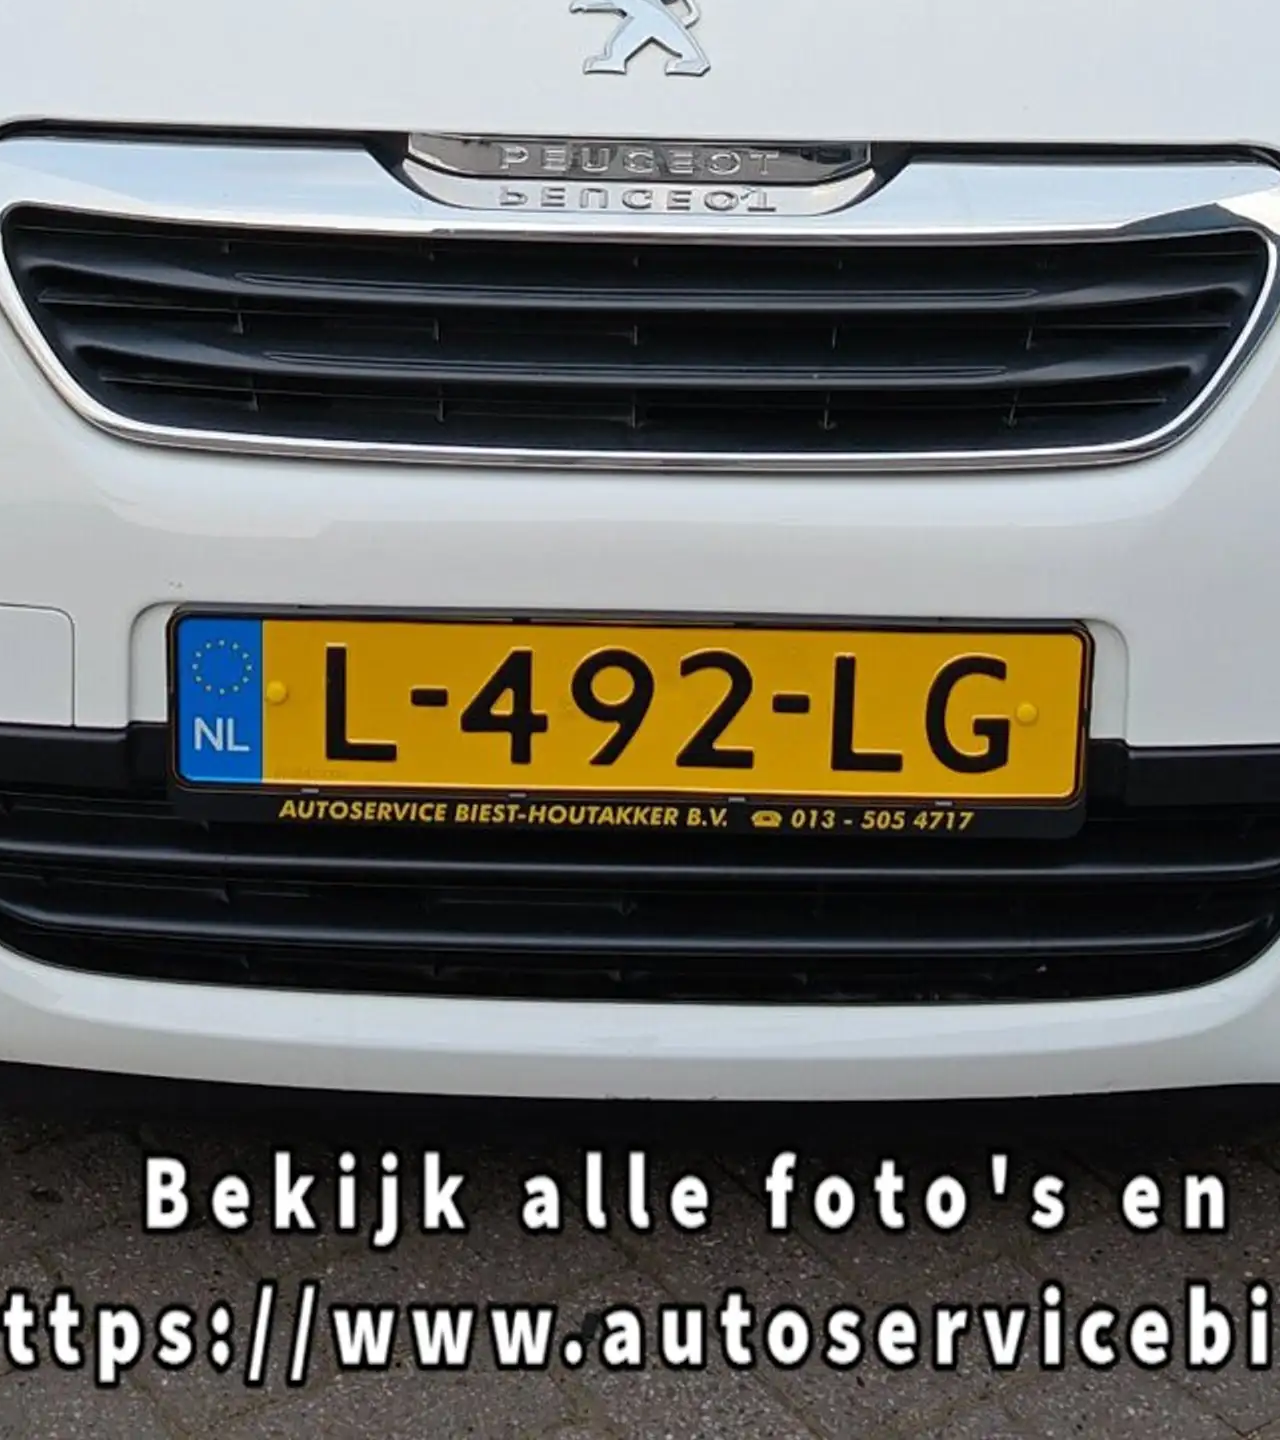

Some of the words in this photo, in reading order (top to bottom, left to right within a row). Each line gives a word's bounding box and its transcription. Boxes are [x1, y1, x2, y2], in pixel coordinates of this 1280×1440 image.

[499, 145, 780, 176] PEUGEOT
[194, 716, 250, 752] NL
[324, 643, 1011, 775] L-492-LG
[278, 799, 447, 823] AUTOSERVICE
[455, 803, 680, 827] BIEST-HOUTAKKER
[686, 808, 728, 827] B.V.
[790, 809, 836, 829] 013
[860, 811, 906, 831] 505
[912, 811, 975, 831] 4717
